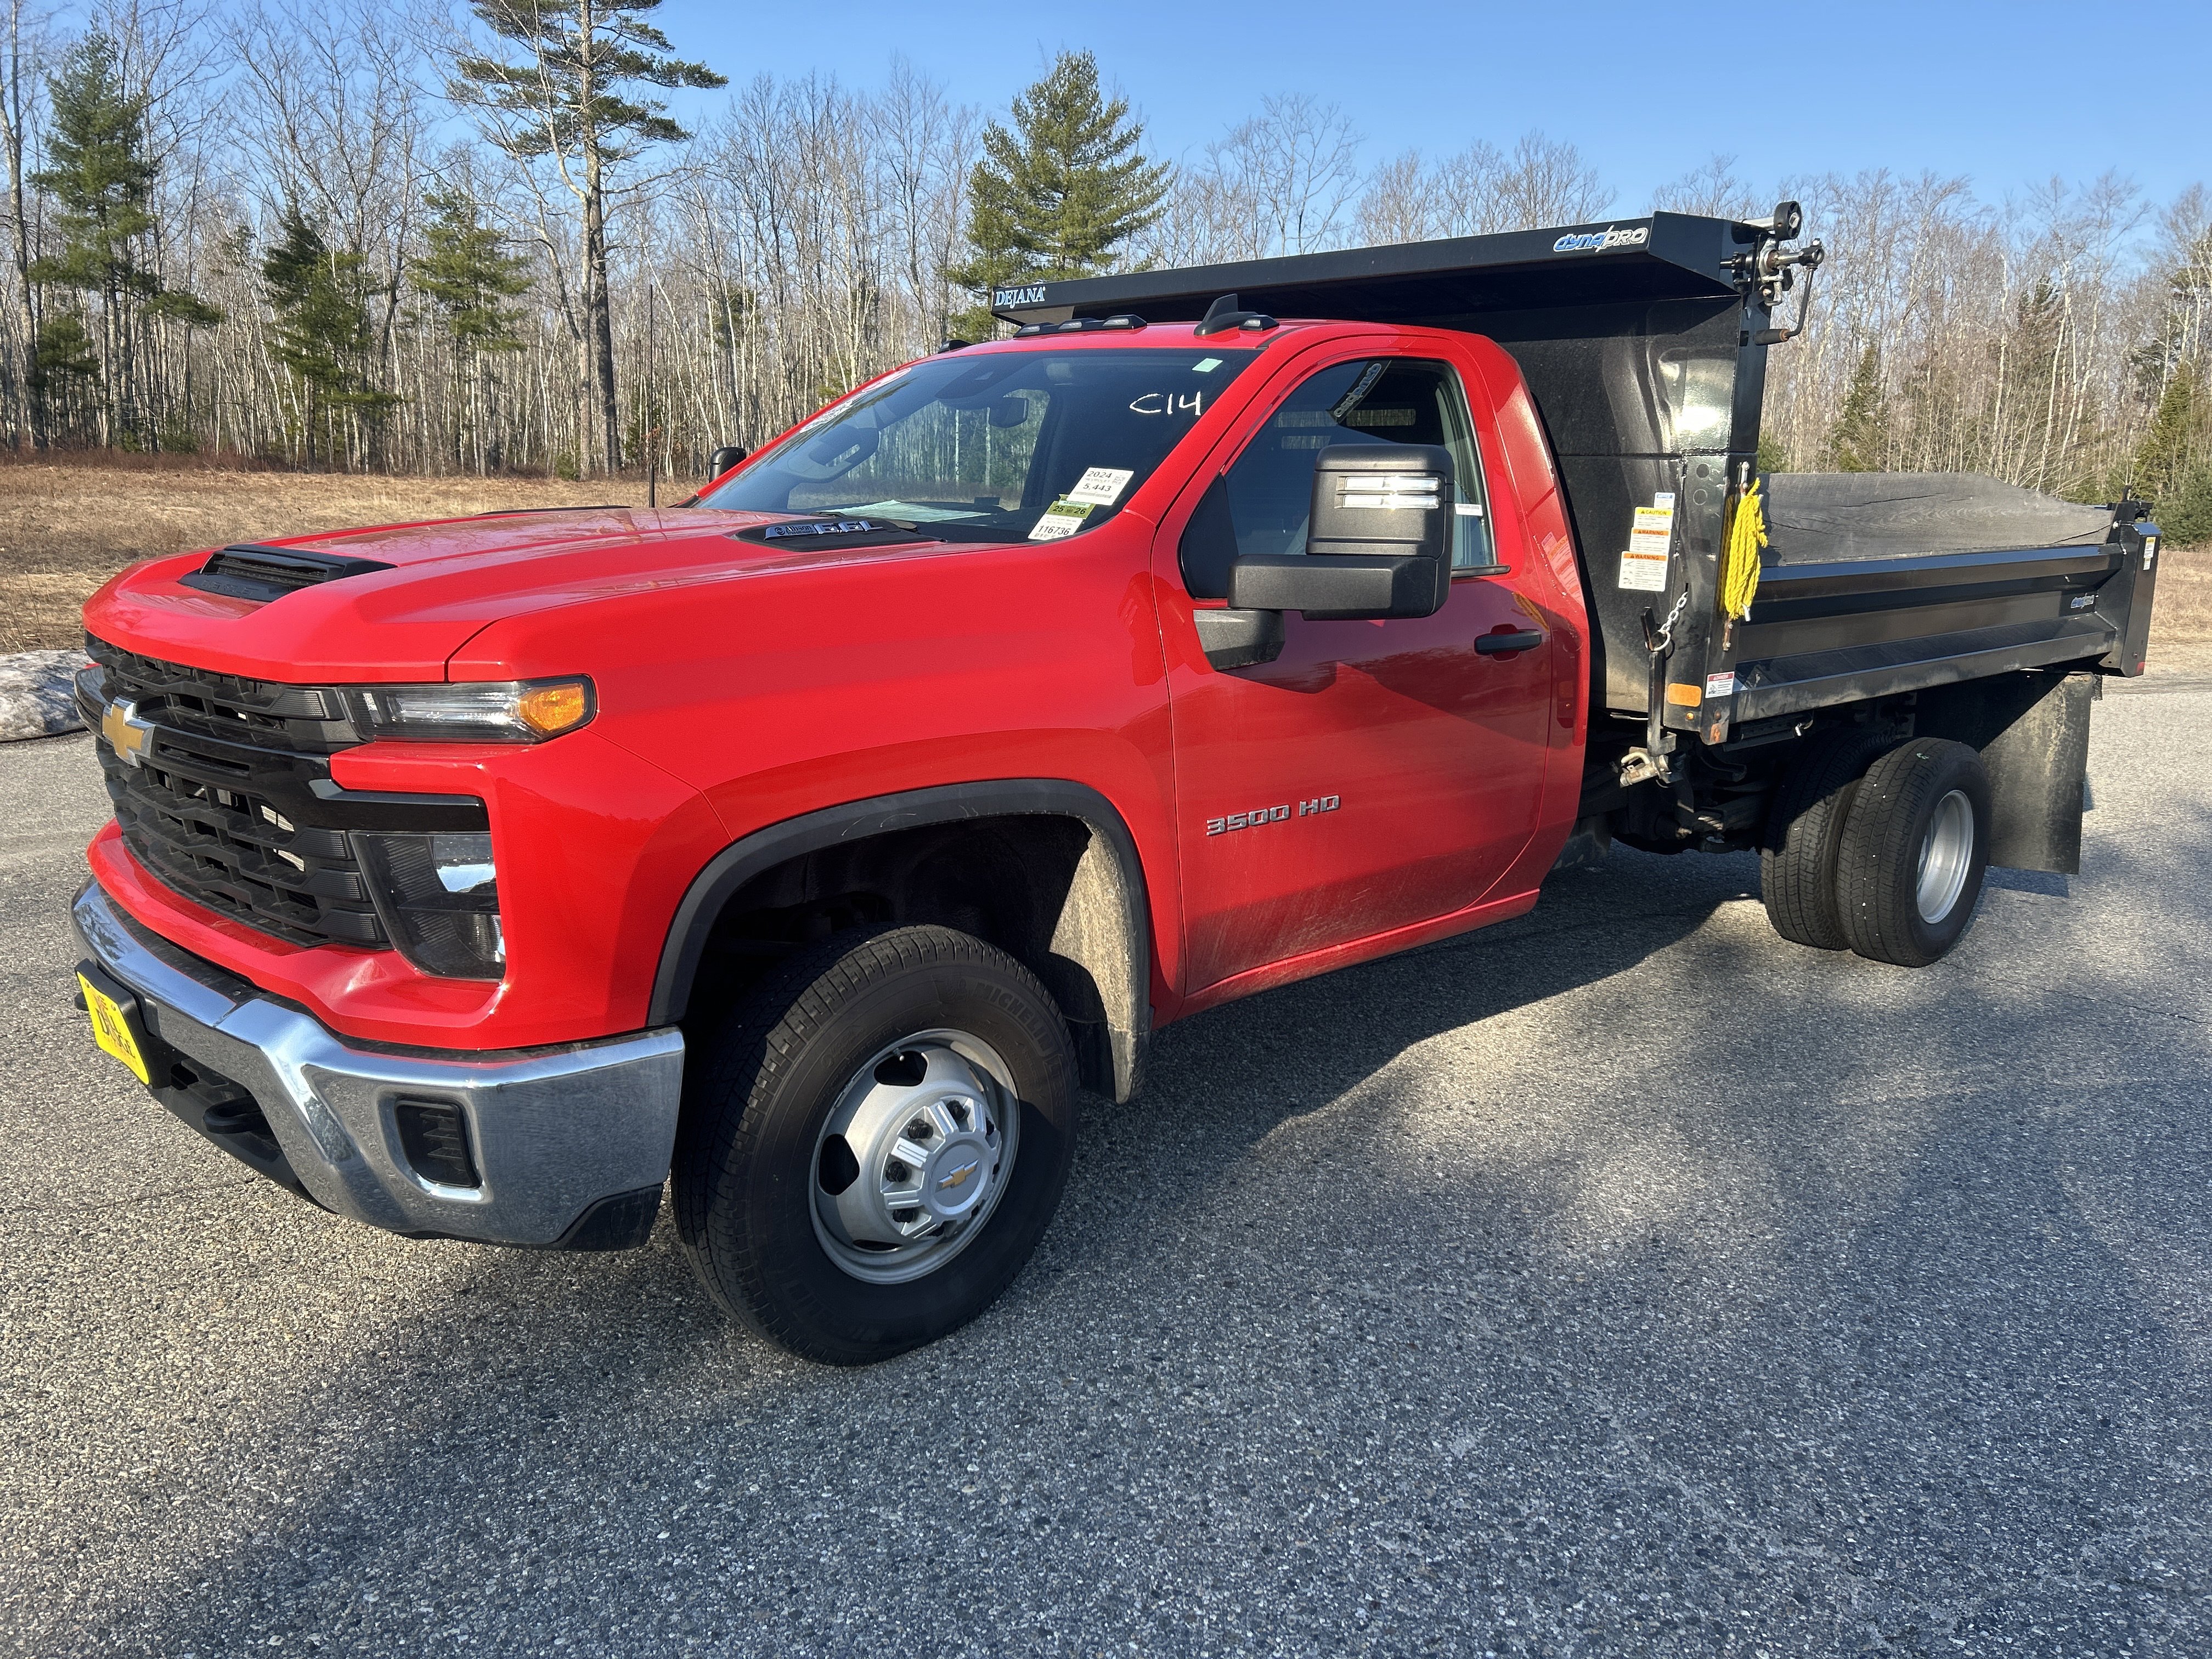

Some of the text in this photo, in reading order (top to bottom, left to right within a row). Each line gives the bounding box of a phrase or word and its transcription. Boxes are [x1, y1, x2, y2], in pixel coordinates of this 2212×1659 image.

[994, 286, 1045, 309] DEJANA
[1129, 391, 1201, 415] C14
[1083, 483, 1111, 492] 5,443
[1038, 525, 1071, 535] 116736
[1206, 794, 1340, 836] 3500 HD
[974, 981, 1054, 1056] MICHELIN
